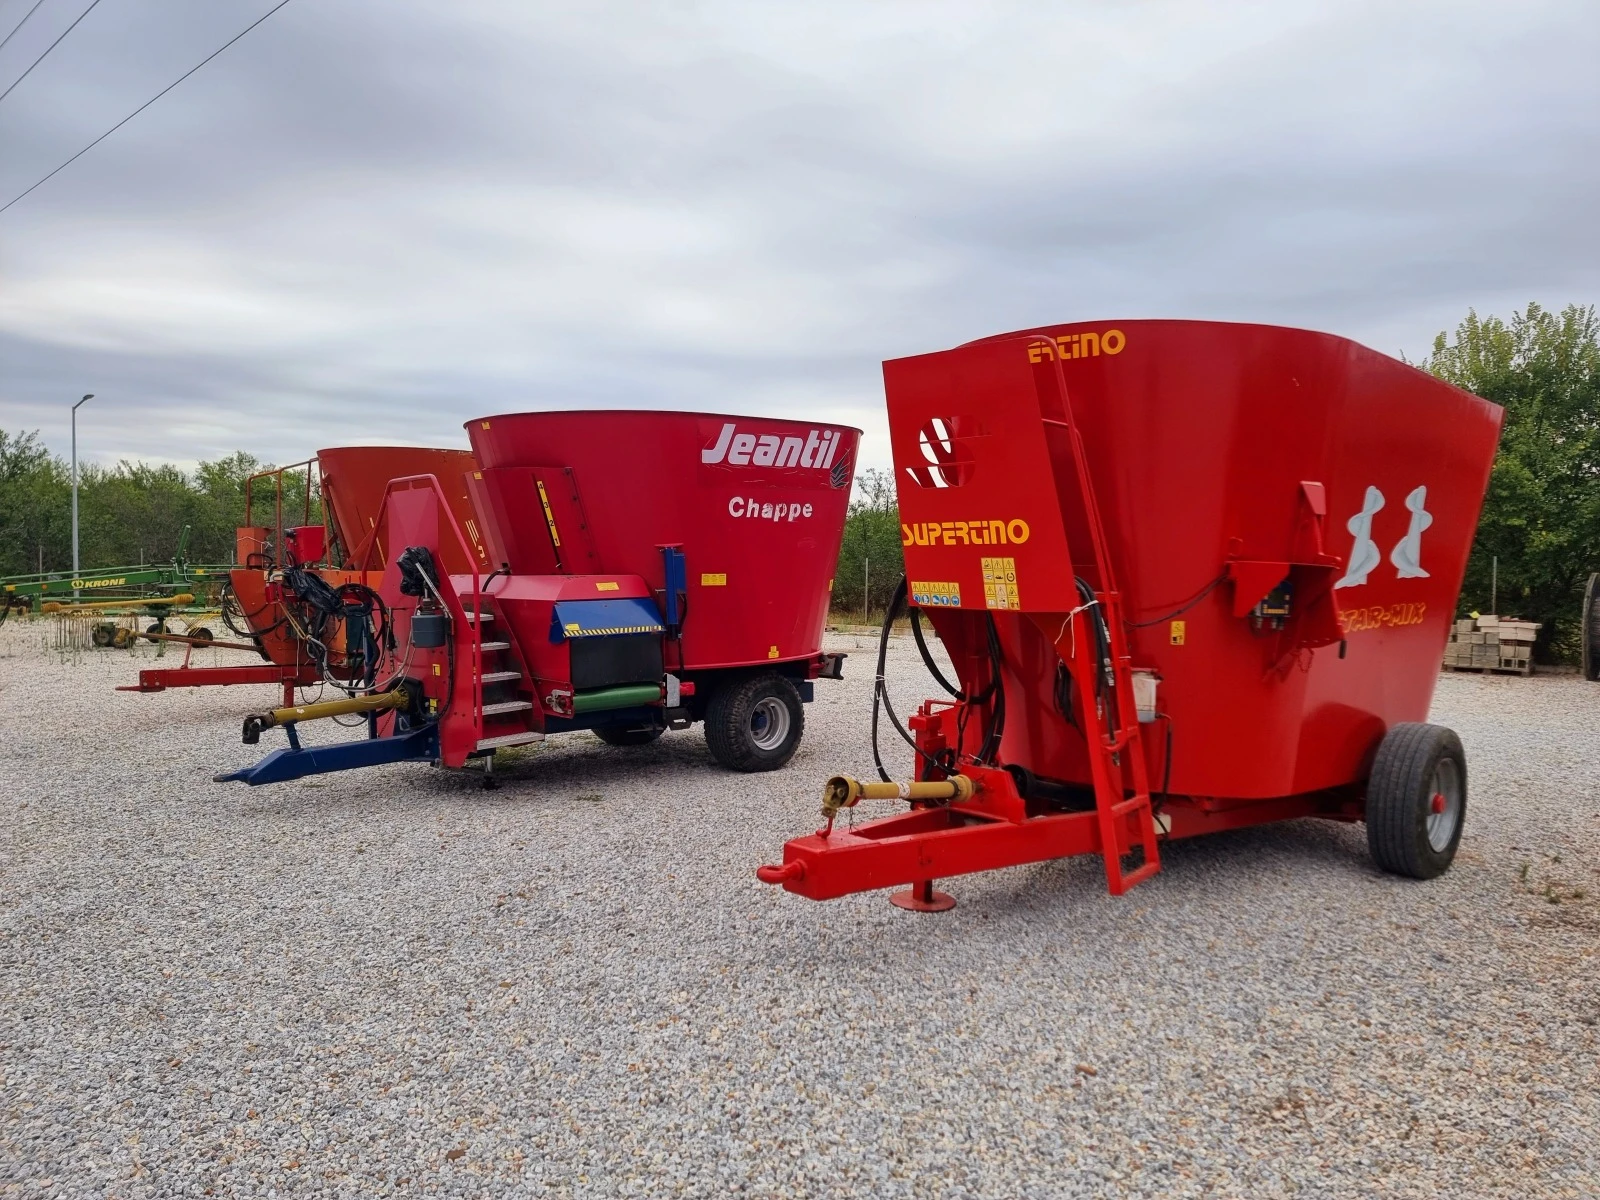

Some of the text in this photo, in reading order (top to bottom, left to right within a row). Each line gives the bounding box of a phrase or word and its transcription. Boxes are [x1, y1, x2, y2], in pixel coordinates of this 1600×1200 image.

[701, 423, 841, 469] Jeantil
[543, 501, 549, 509] 3
[728, 496, 813, 522] Chappe
[549, 519, 555, 527] 2
[901, 518, 1030, 547] SUPERTINO
[84, 577, 127, 589] KRONE
